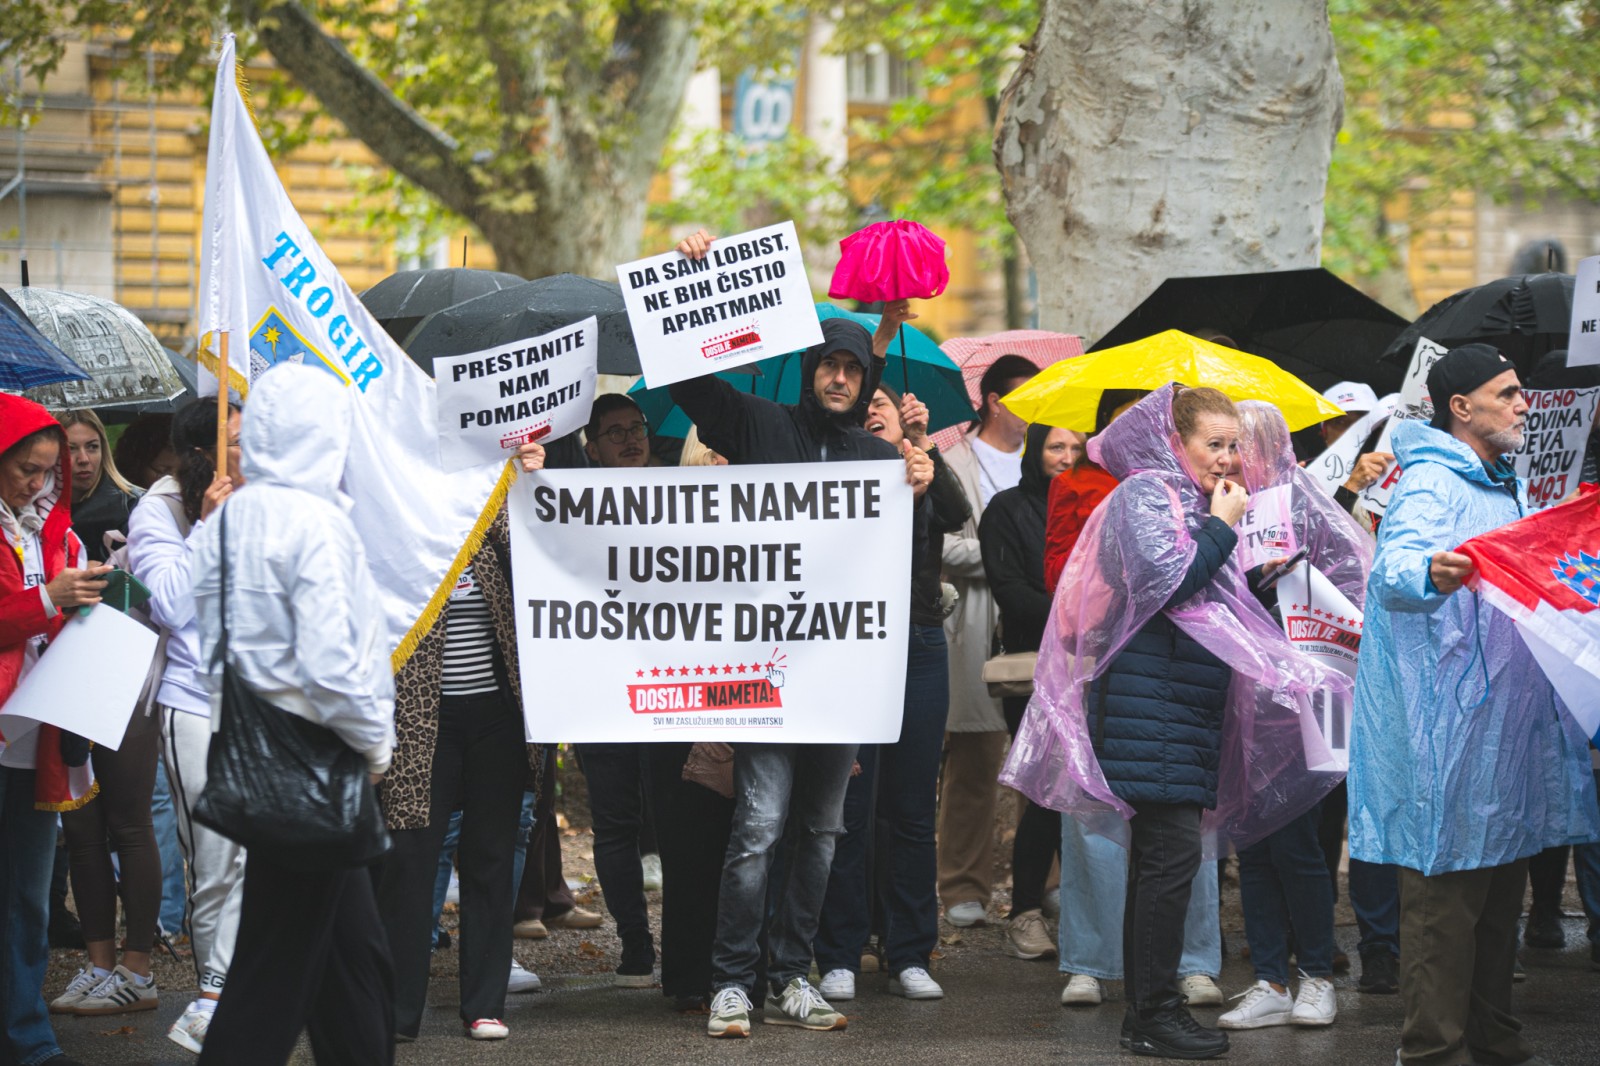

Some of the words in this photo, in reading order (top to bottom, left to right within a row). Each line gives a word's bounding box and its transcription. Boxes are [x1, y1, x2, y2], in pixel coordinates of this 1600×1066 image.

[628, 267, 660, 290] DA
[662, 257, 710, 281] SAM
[713, 233, 789, 268] LOBIST,
[643, 290, 672, 313] NE
[674, 279, 713, 305] BIH
[716, 260, 786, 294] ČISTIO
[262, 231, 384, 394] TROGIR
[662, 287, 783, 336] APARTMAN!
[1581, 320, 1597, 333] NE
[452, 329, 585, 382] PRESTANITE
[460, 380, 582, 429] POMAGATI!
[499, 368, 549, 398] NAM
[1527, 450, 1577, 478] MOJU
[534, 484, 720, 525] SMANJITE
[730, 479, 881, 522] NAMETE
[1527, 474, 1569, 502] MOJ
[608, 546, 617, 581] I
[629, 543, 802, 583] USIDRITE
[528, 589, 722, 642] TROŠKOVE
[734, 591, 888, 642] DRŽAVE!
[1290, 620, 1322, 639] DOSTA
[1320, 626, 1338, 640] JE
[1336, 631, 1362, 649] NA
[636, 687, 685, 711] DOSTA
[687, 685, 703, 708] JE
[707, 681, 774, 707] NAMETA!
[653, 717, 665, 726] SVI
[666, 717, 675, 725] MI
[676, 716, 724, 726] ZASLUŽUJEMO
[725, 717, 747, 726] BOLJU
[748, 717, 784, 726] HRVATSKU
